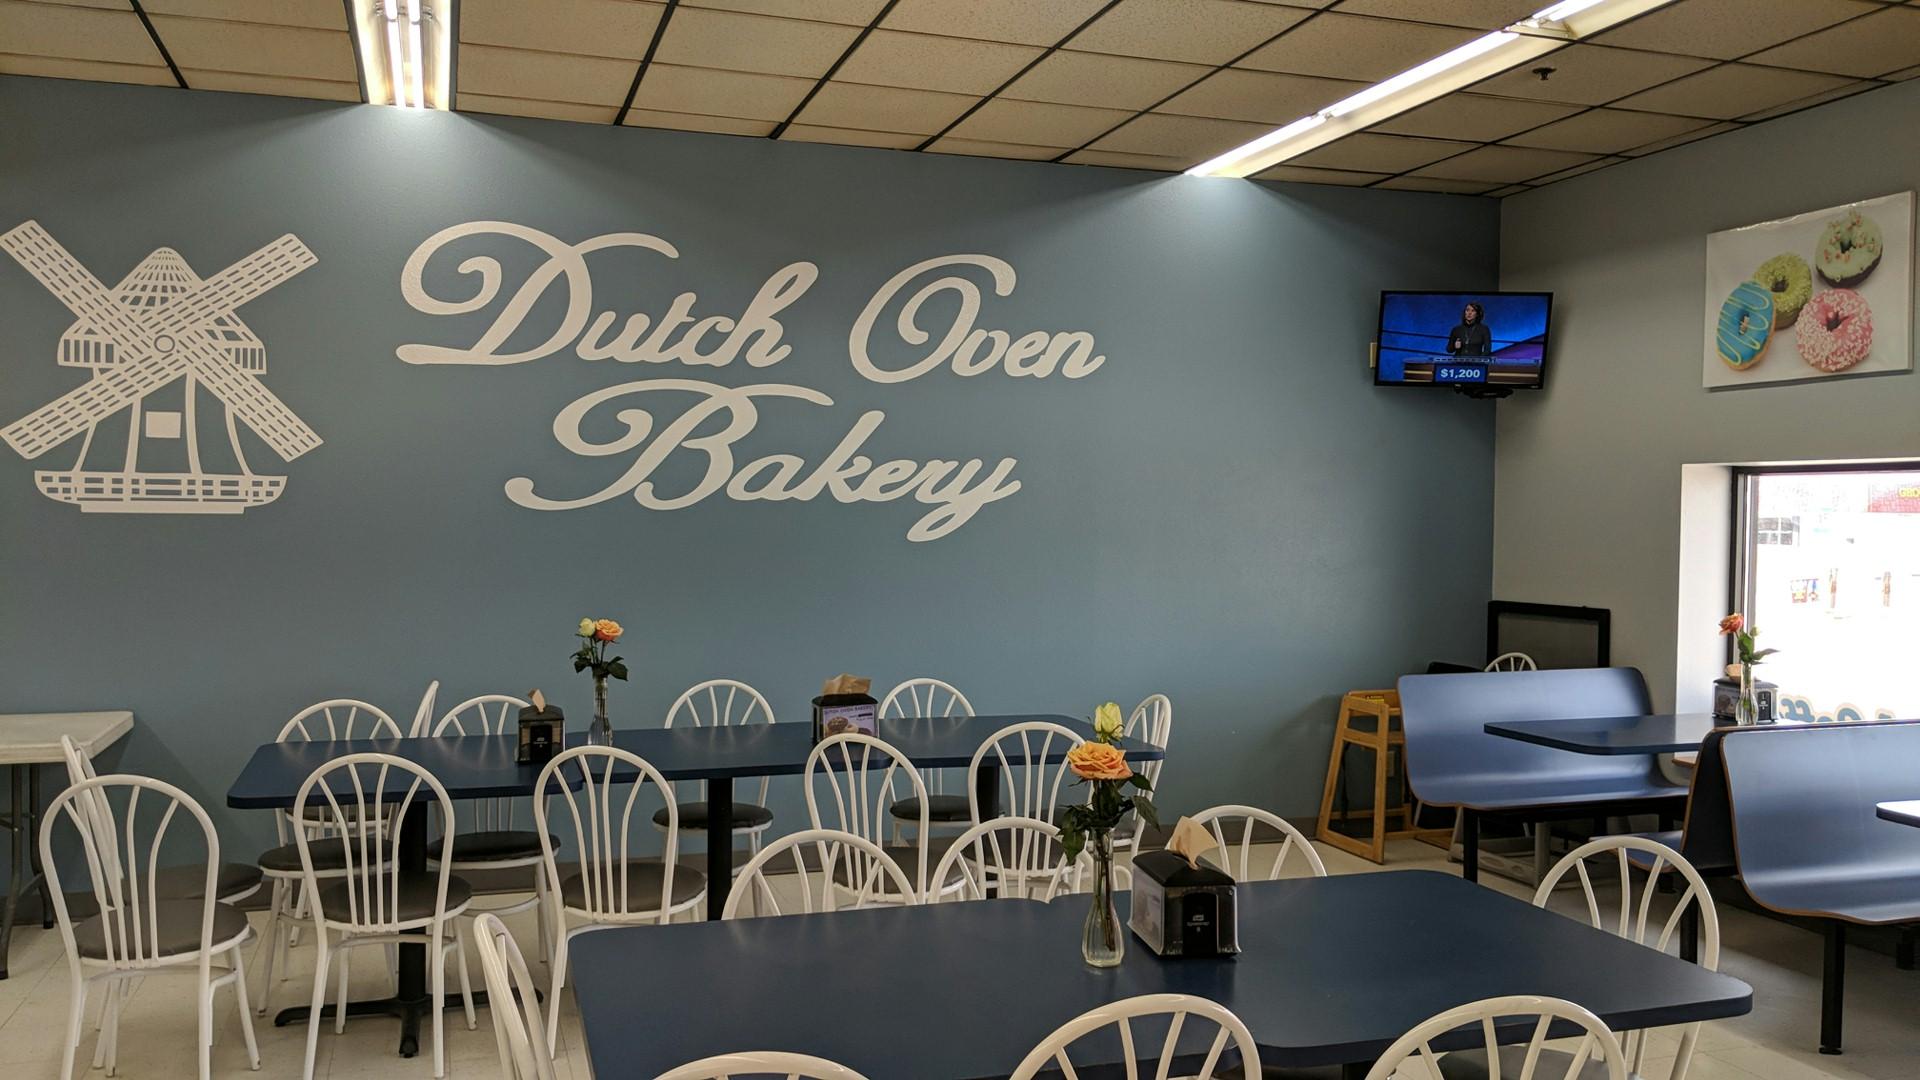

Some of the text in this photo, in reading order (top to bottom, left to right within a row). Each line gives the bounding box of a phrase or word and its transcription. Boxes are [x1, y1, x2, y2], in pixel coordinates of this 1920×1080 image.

[396, 220, 1106, 384] Dutch Oven
[1440, 368, 1480, 379] $1,200
[504, 378, 1022, 542] Bakery
